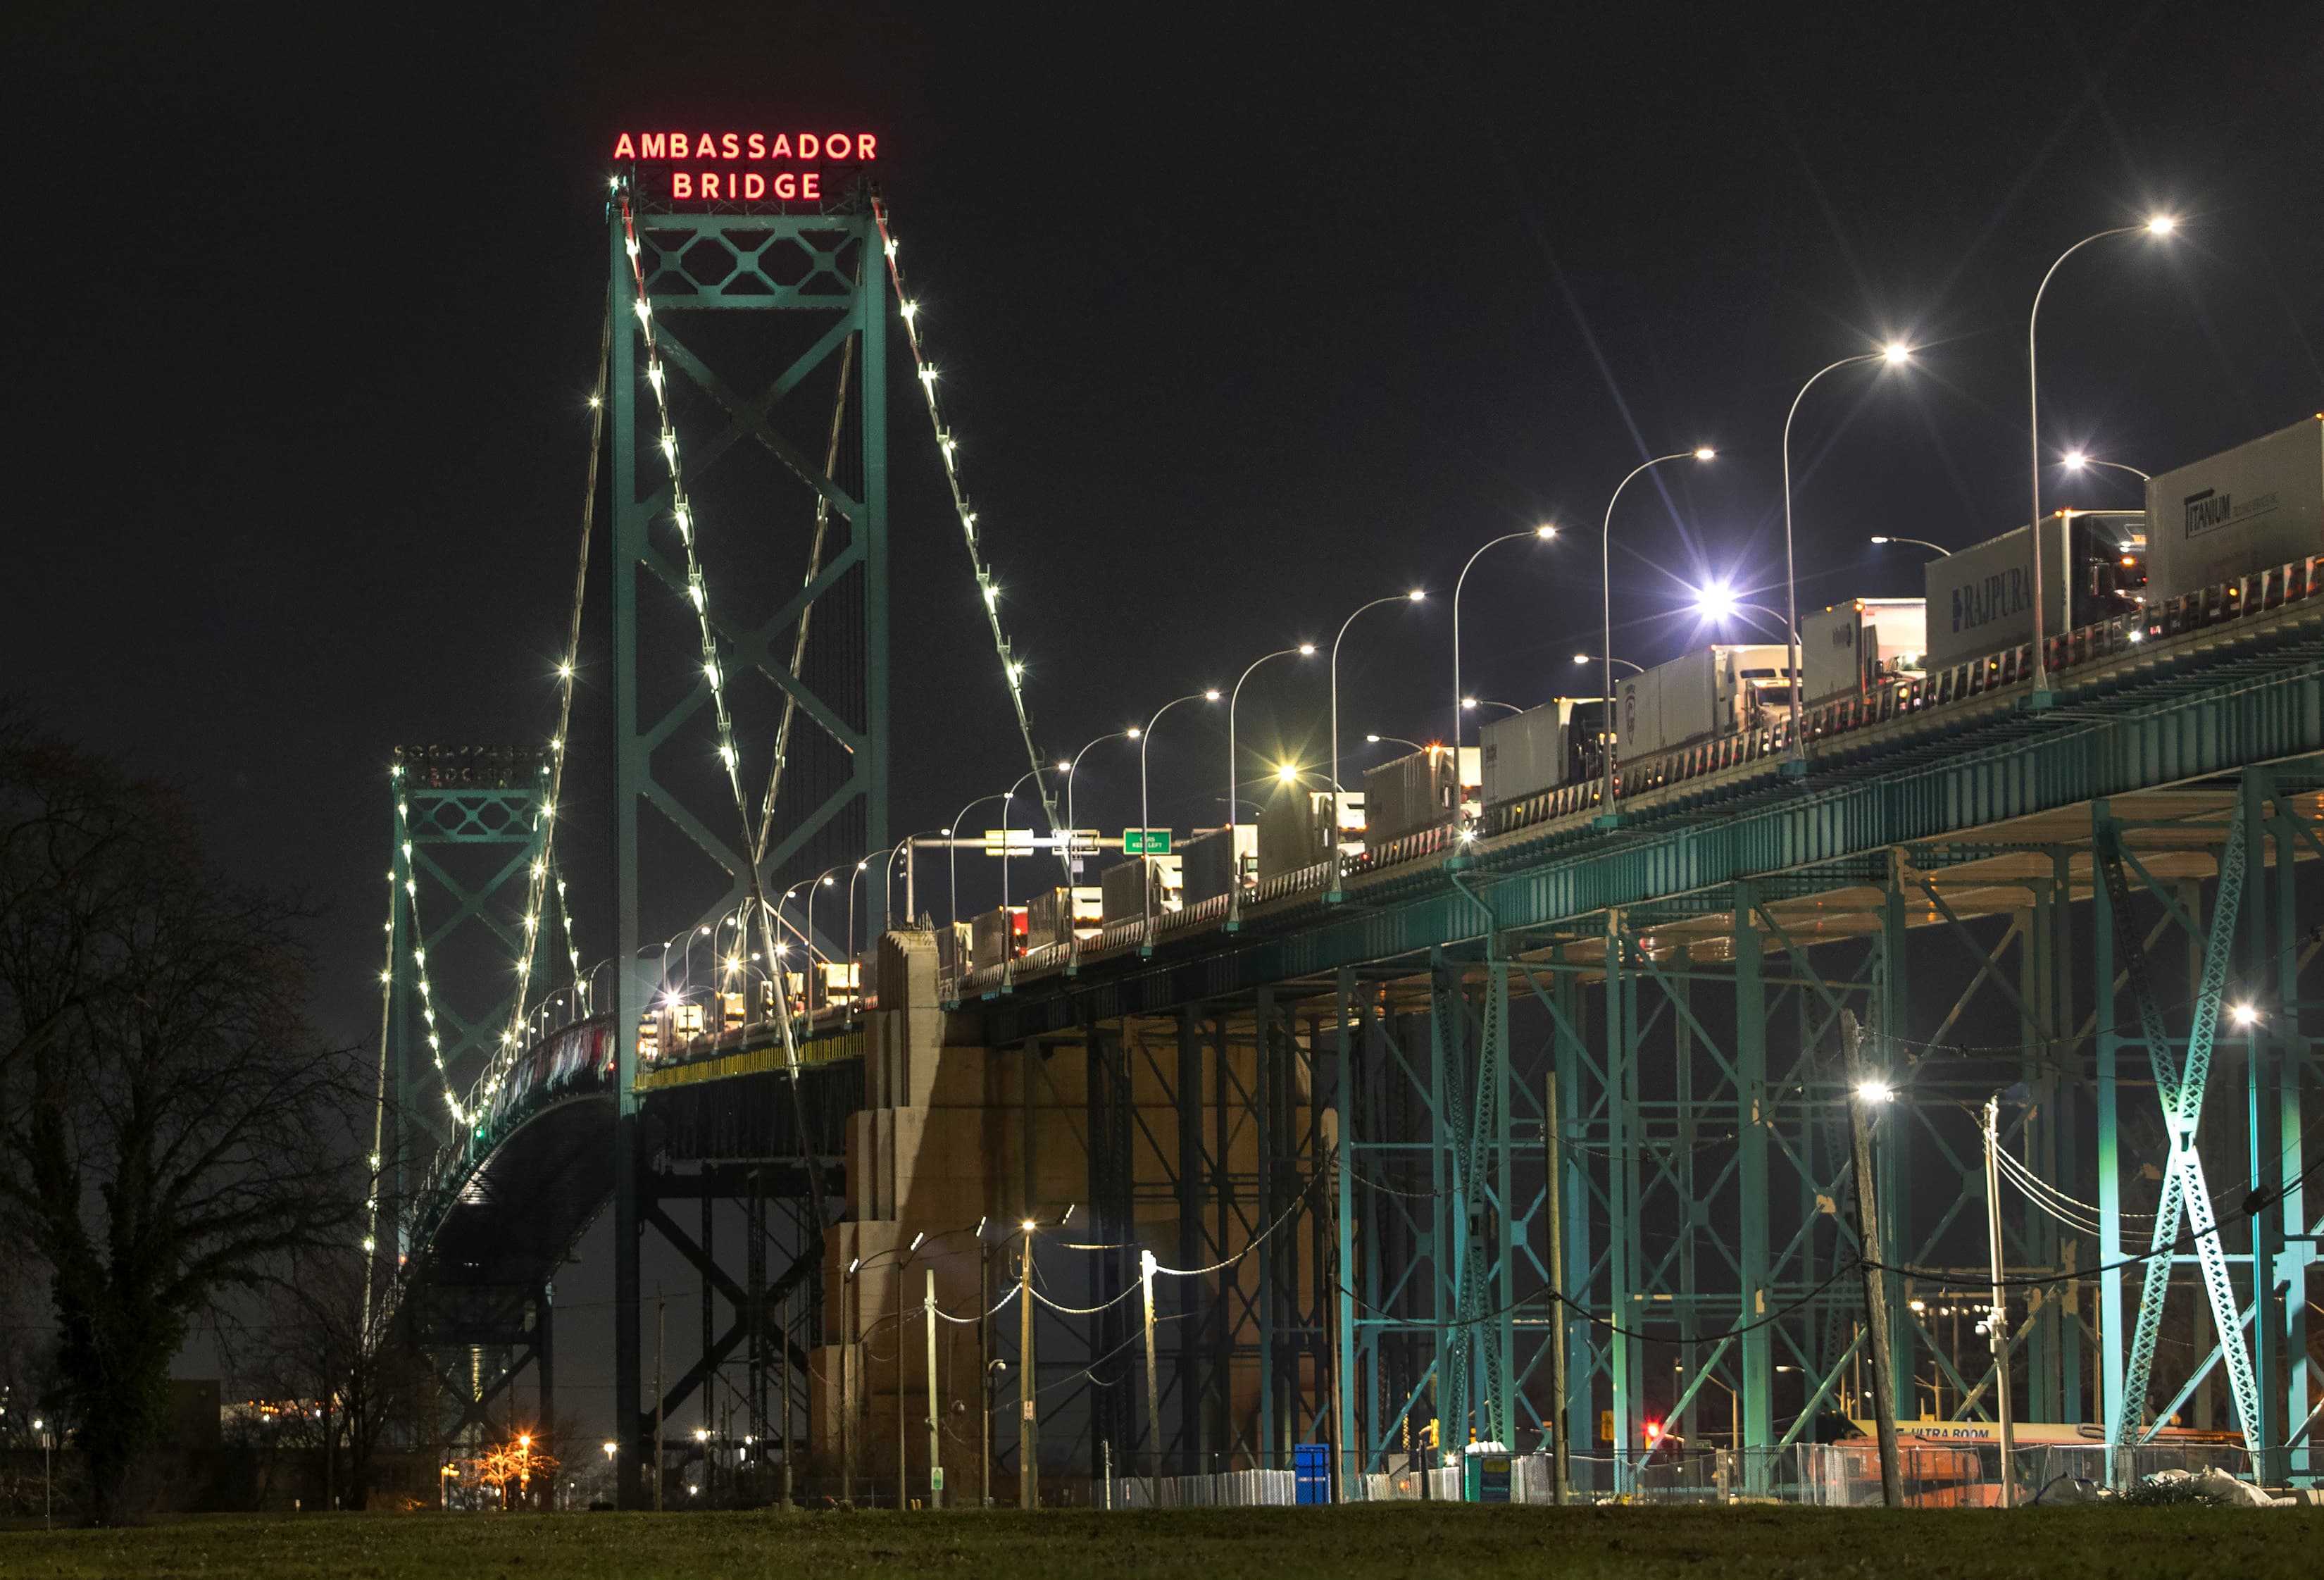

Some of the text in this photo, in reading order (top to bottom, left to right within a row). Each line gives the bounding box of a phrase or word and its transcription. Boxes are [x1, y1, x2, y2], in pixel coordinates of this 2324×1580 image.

[613, 132, 877, 160] AMBASSADOR
[672, 172, 822, 200] BRIDGE
[2184, 487, 2230, 540] TITANIUM
[1964, 564, 2032, 630] RAJPURA
[1952, 1428, 1989, 1438] BOOM
